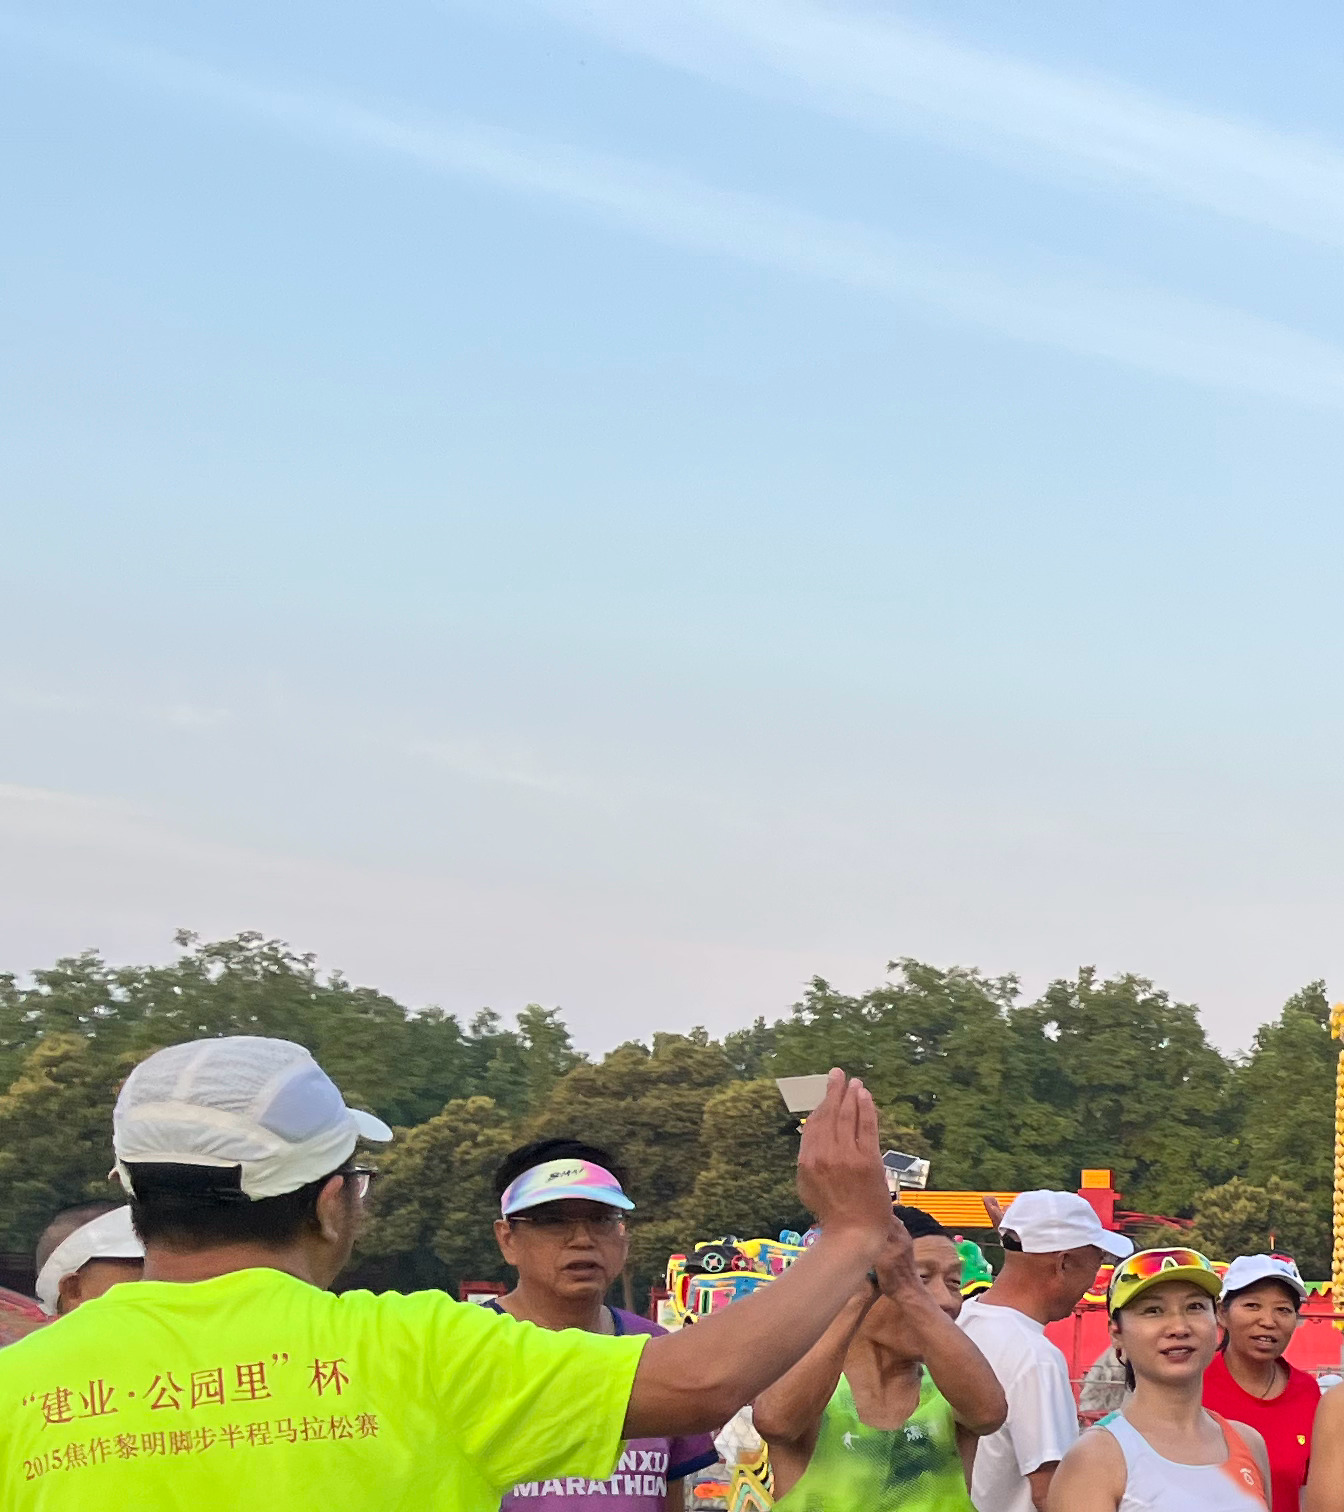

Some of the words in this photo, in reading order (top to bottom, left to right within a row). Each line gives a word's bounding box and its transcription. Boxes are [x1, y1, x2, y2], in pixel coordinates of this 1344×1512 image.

[23, 1412, 380, 1481] 2015焦作黎明脚步半程马拉松赛
[513, 1473, 669, 1498] MARATHON
